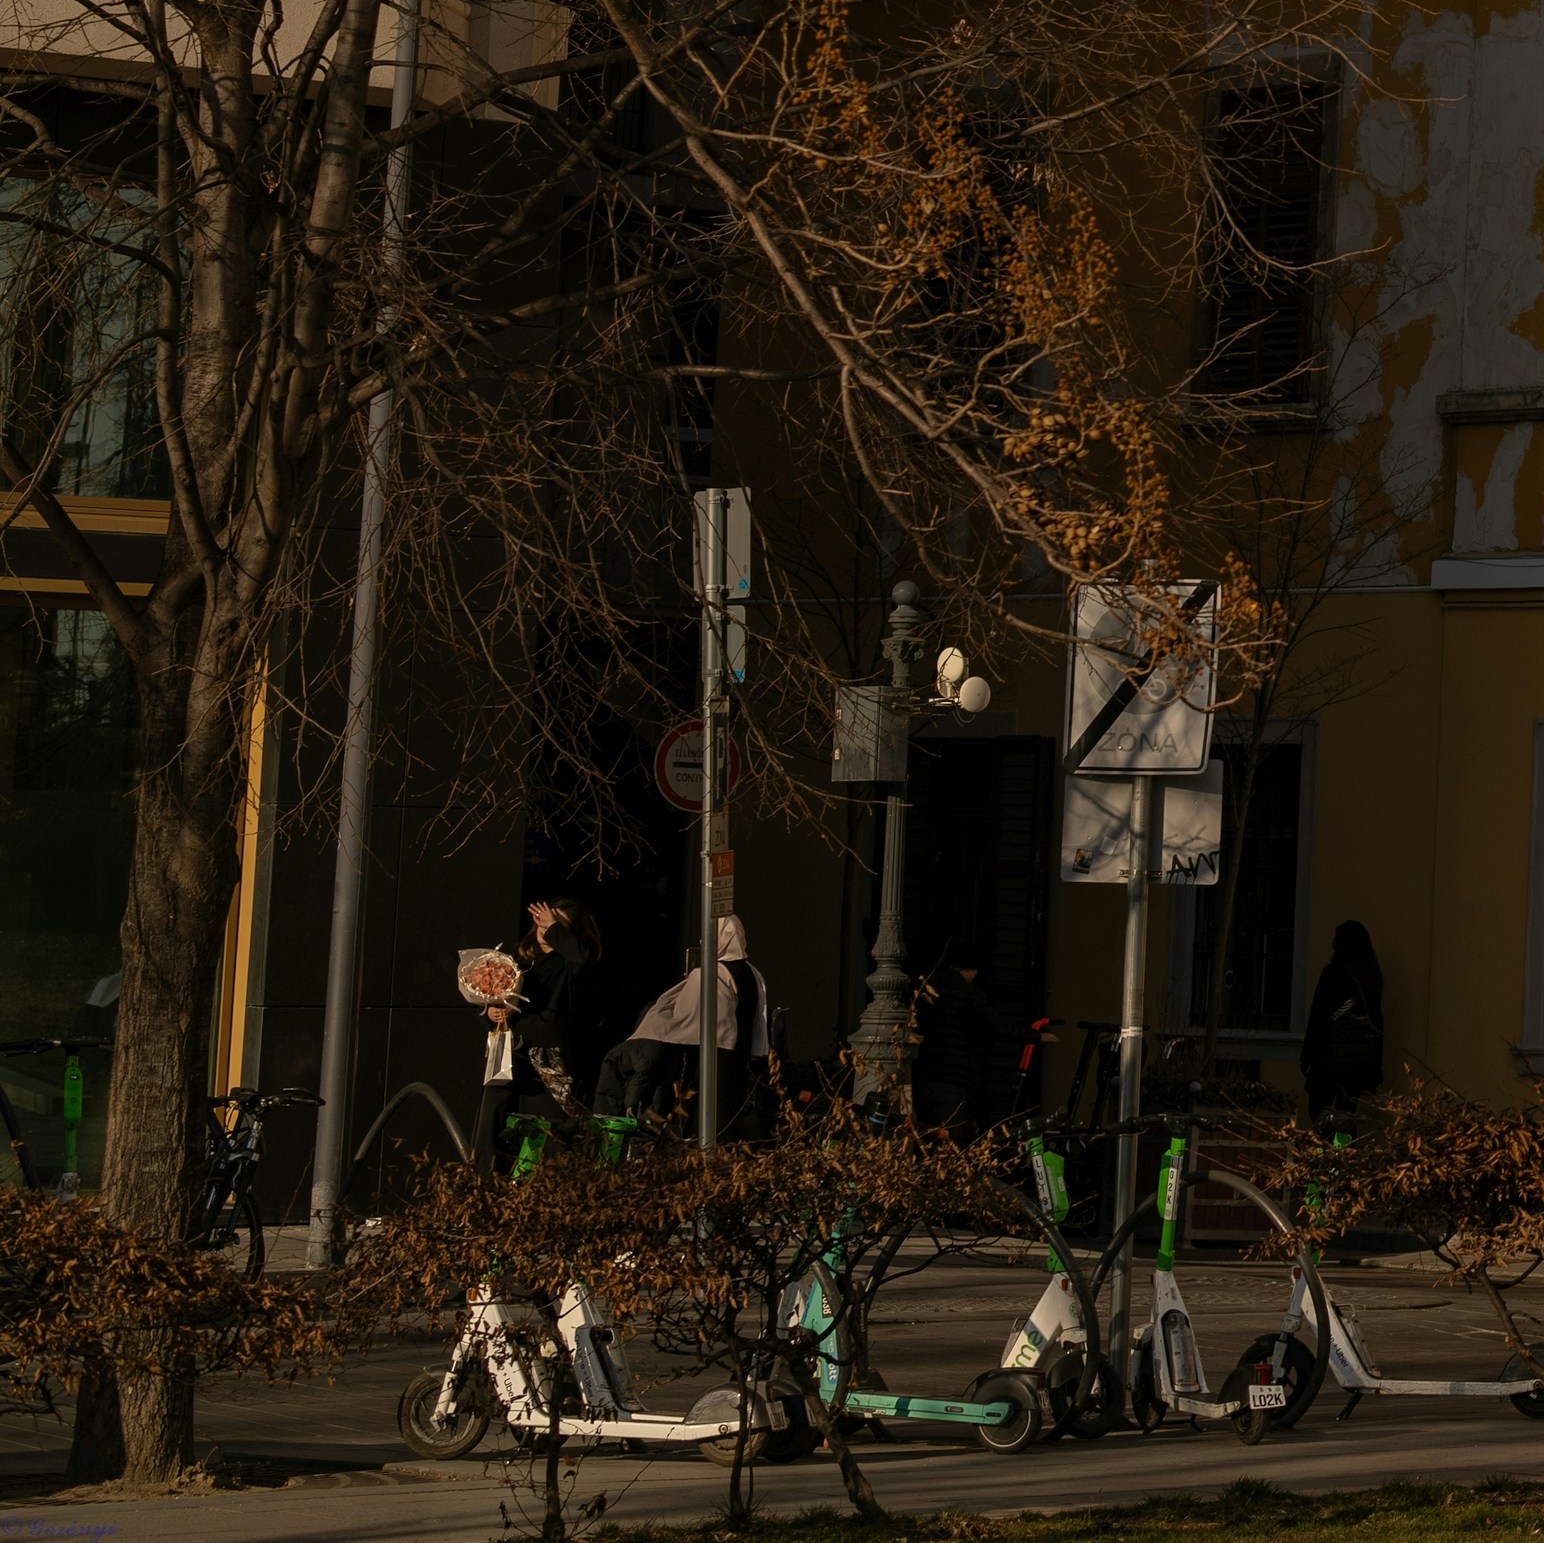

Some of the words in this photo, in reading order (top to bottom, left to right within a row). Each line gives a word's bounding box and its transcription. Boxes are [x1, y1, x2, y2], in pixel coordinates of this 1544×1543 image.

[1098, 727, 1178, 753] ZÓNA
[1335, 1348, 1348, 1368] Uber
[503, 1378, 514, 1398] Ube
